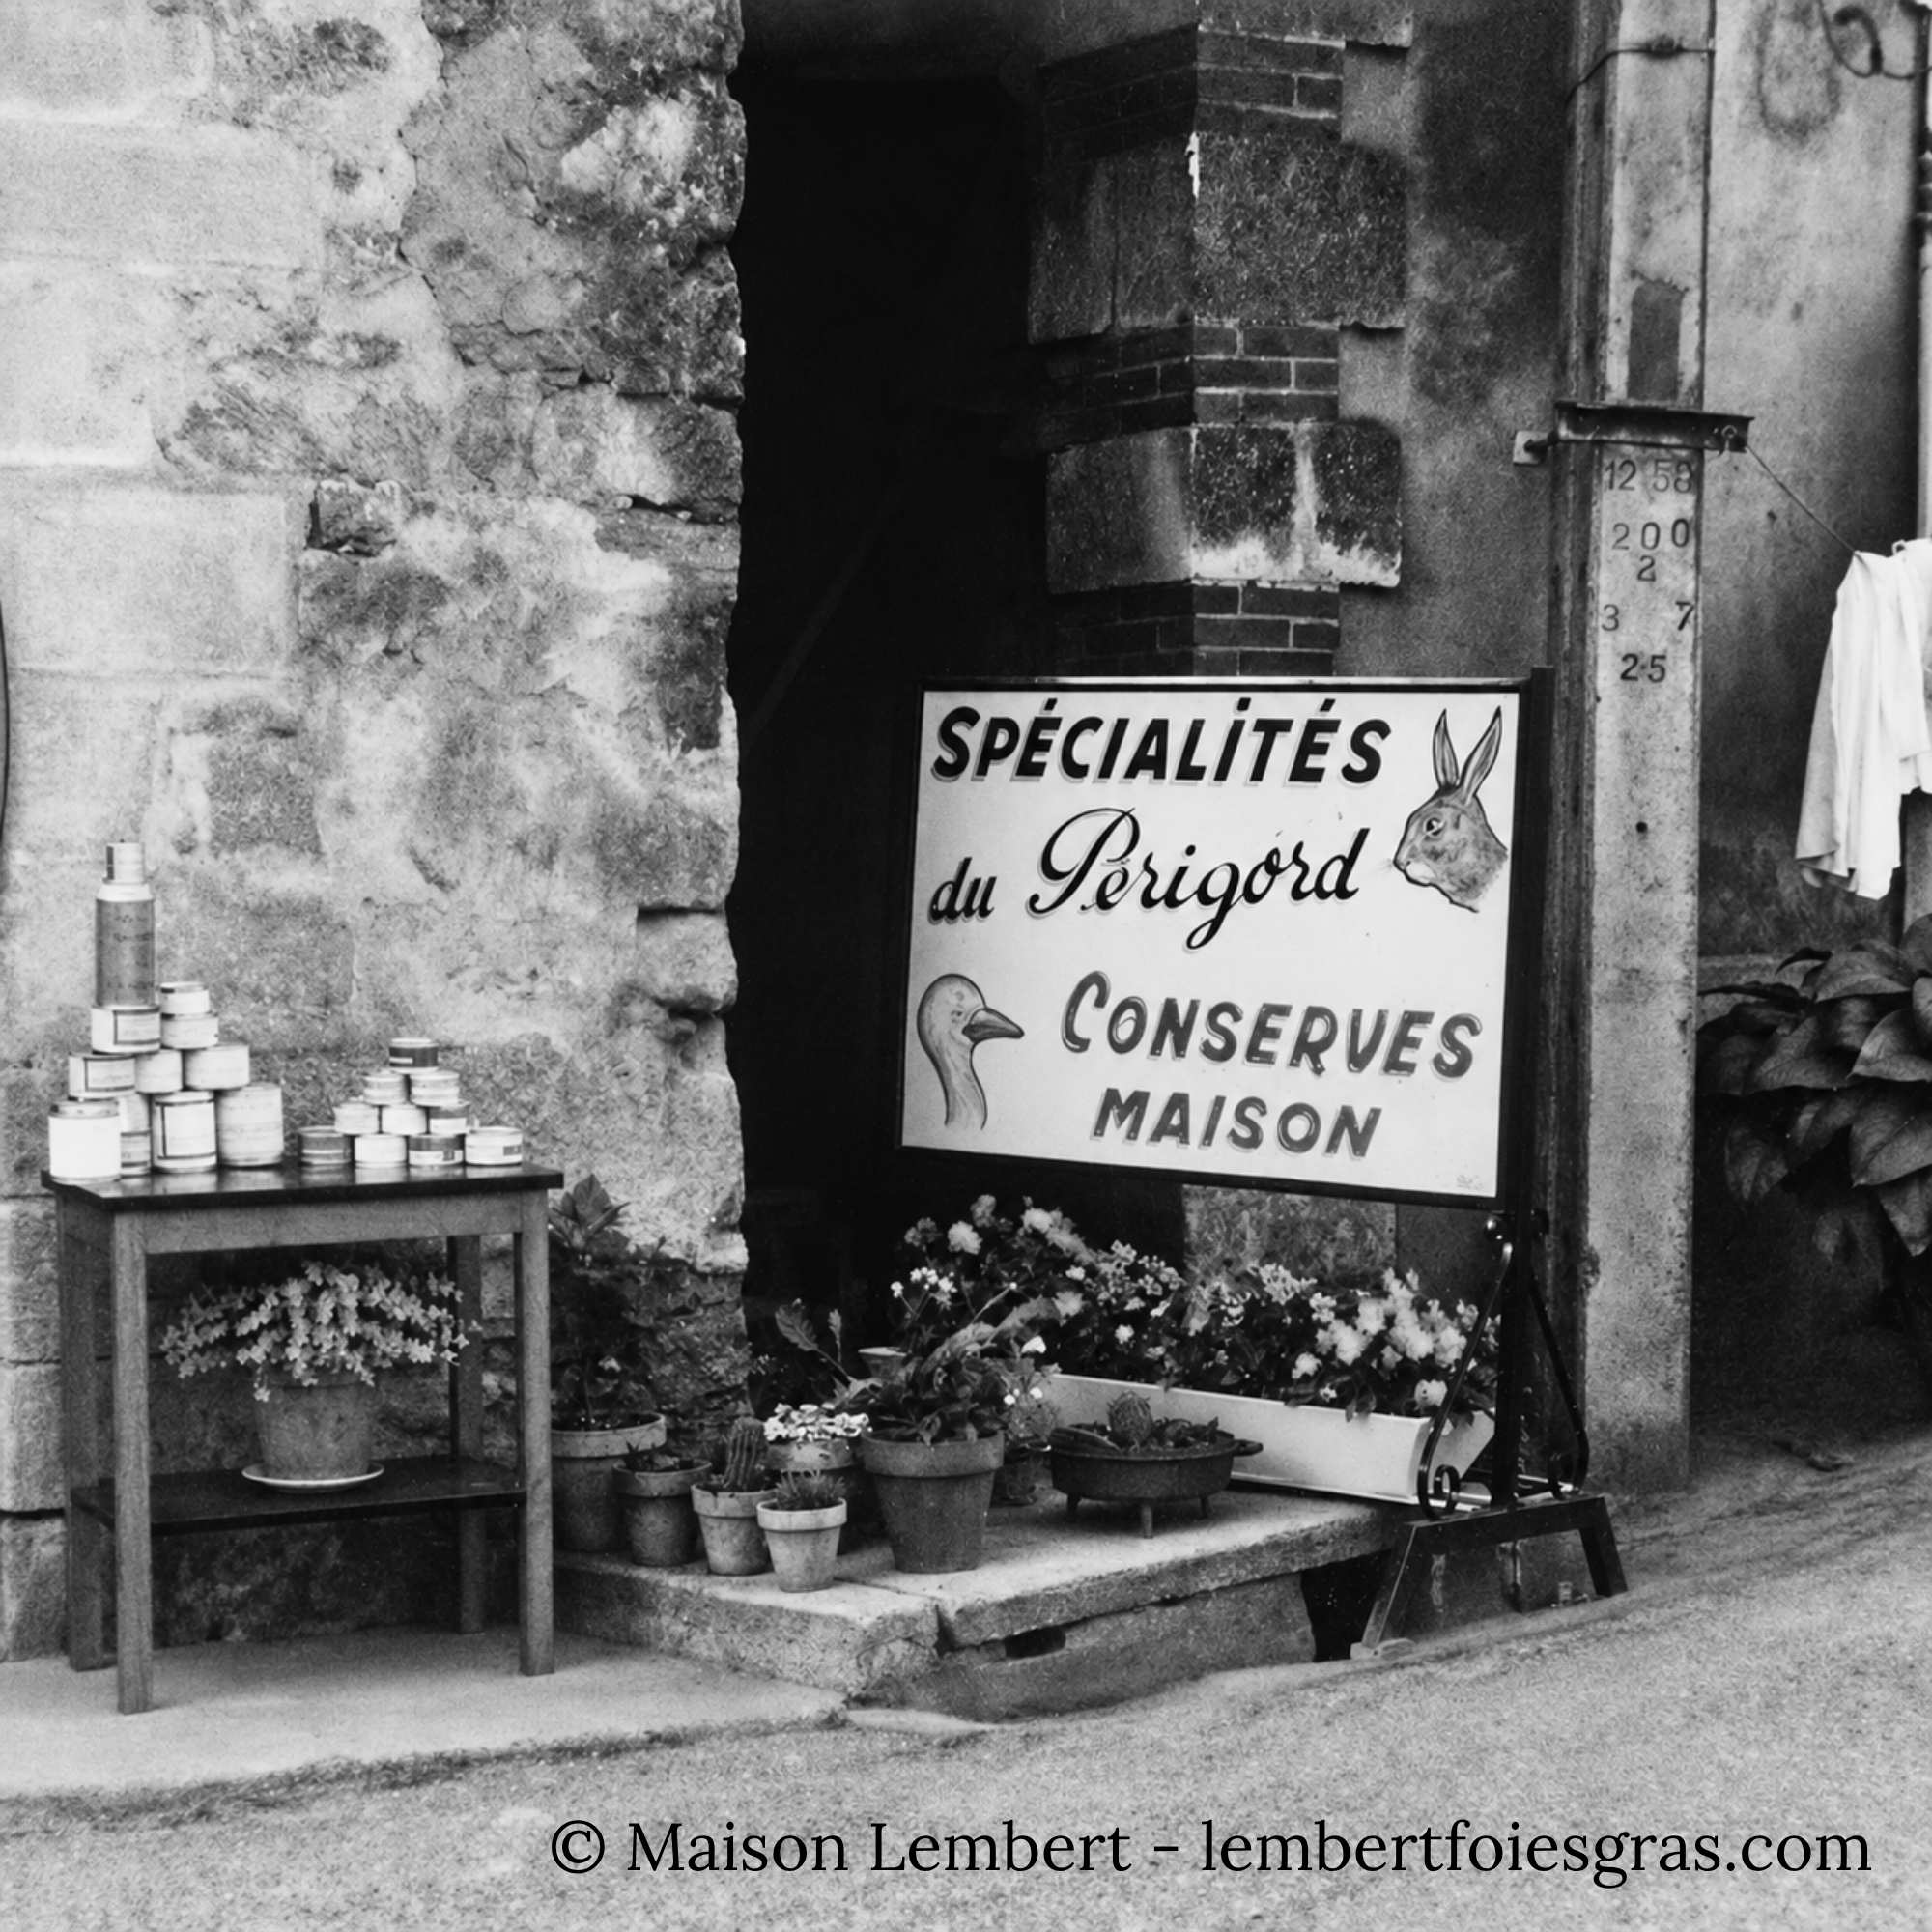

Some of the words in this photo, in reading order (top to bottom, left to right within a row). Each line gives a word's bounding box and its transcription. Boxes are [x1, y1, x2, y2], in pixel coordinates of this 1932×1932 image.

[1605, 459, 1636, 491] 12
[1653, 459, 1692, 494] 58
[1637, 555, 1657, 582] 2
[1602, 604, 1620, 631] 3
[1675, 600, 1695, 631] 7
[926, 856, 998, 923] du
[1062, 970, 1483, 1080] CONSERVES
[1092, 1087, 1383, 1158] MAISON
